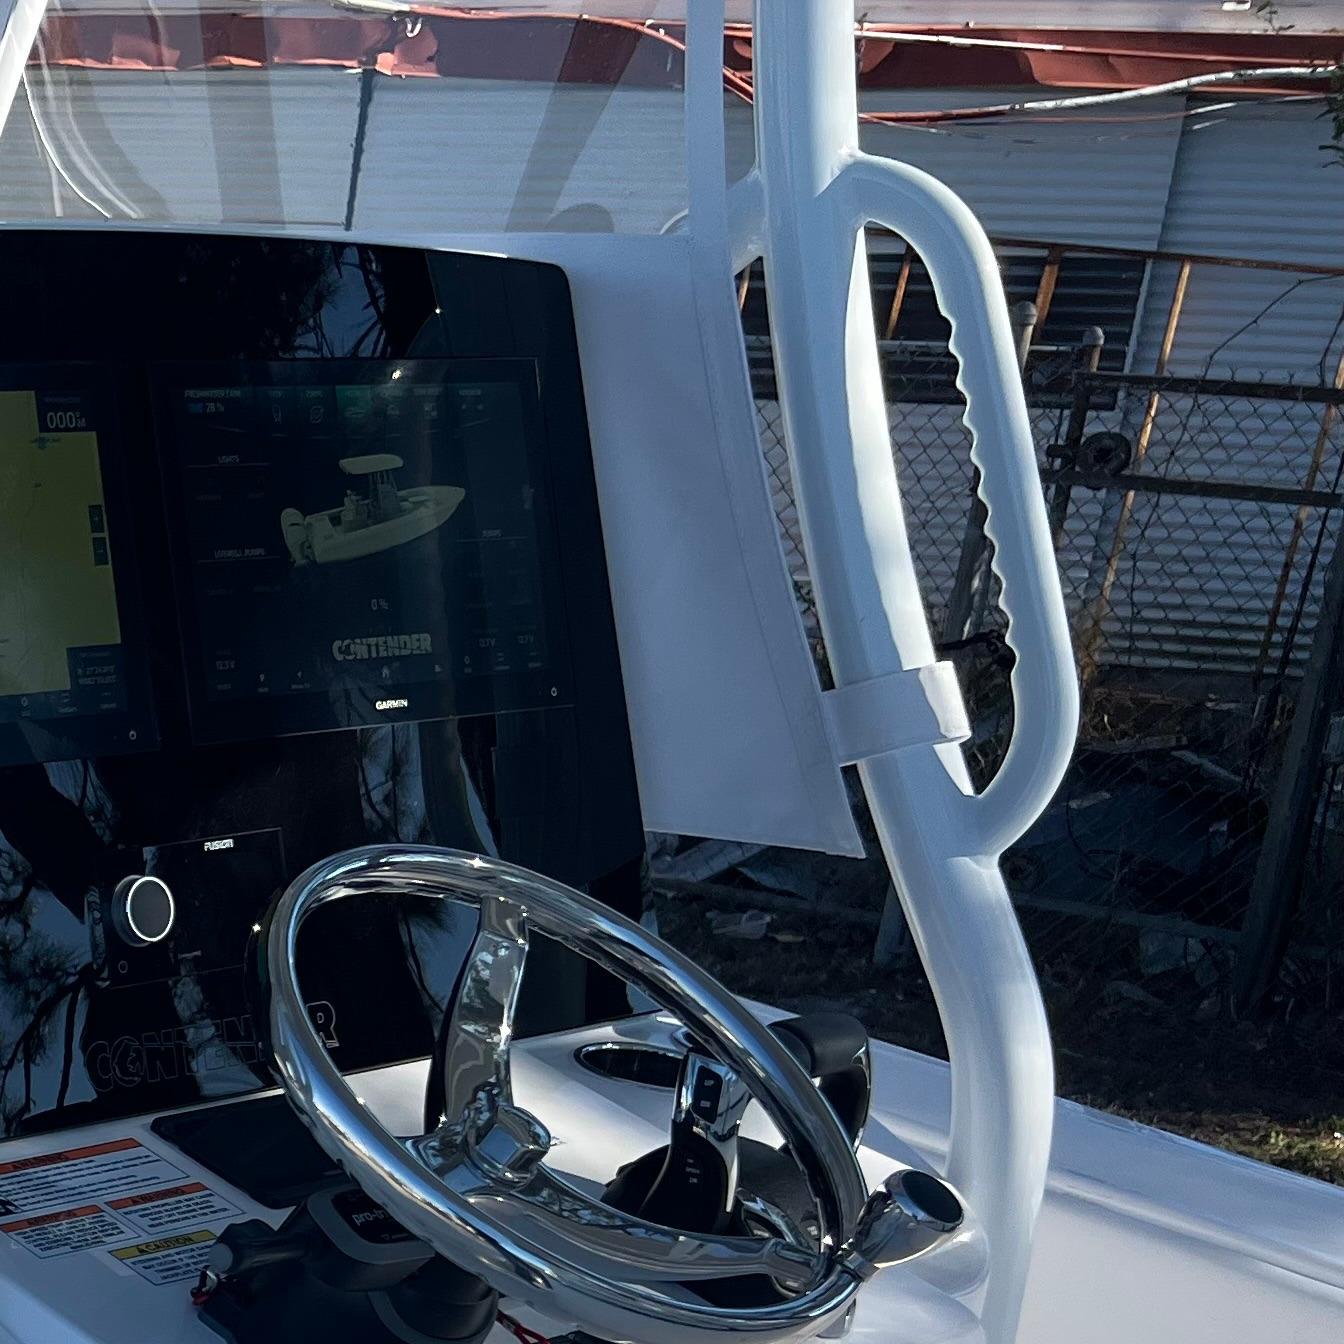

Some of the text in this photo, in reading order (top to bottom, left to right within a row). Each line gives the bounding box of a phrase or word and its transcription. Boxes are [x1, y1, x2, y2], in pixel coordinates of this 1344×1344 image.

[332, 633, 432, 661] CONTENDER
[375, 699, 408, 710] GARMIN
[204, 838, 234, 851] FUSION
[88, 1000, 340, 1093] CONTENR
[144, 1235, 195, 1252] CAUTION
